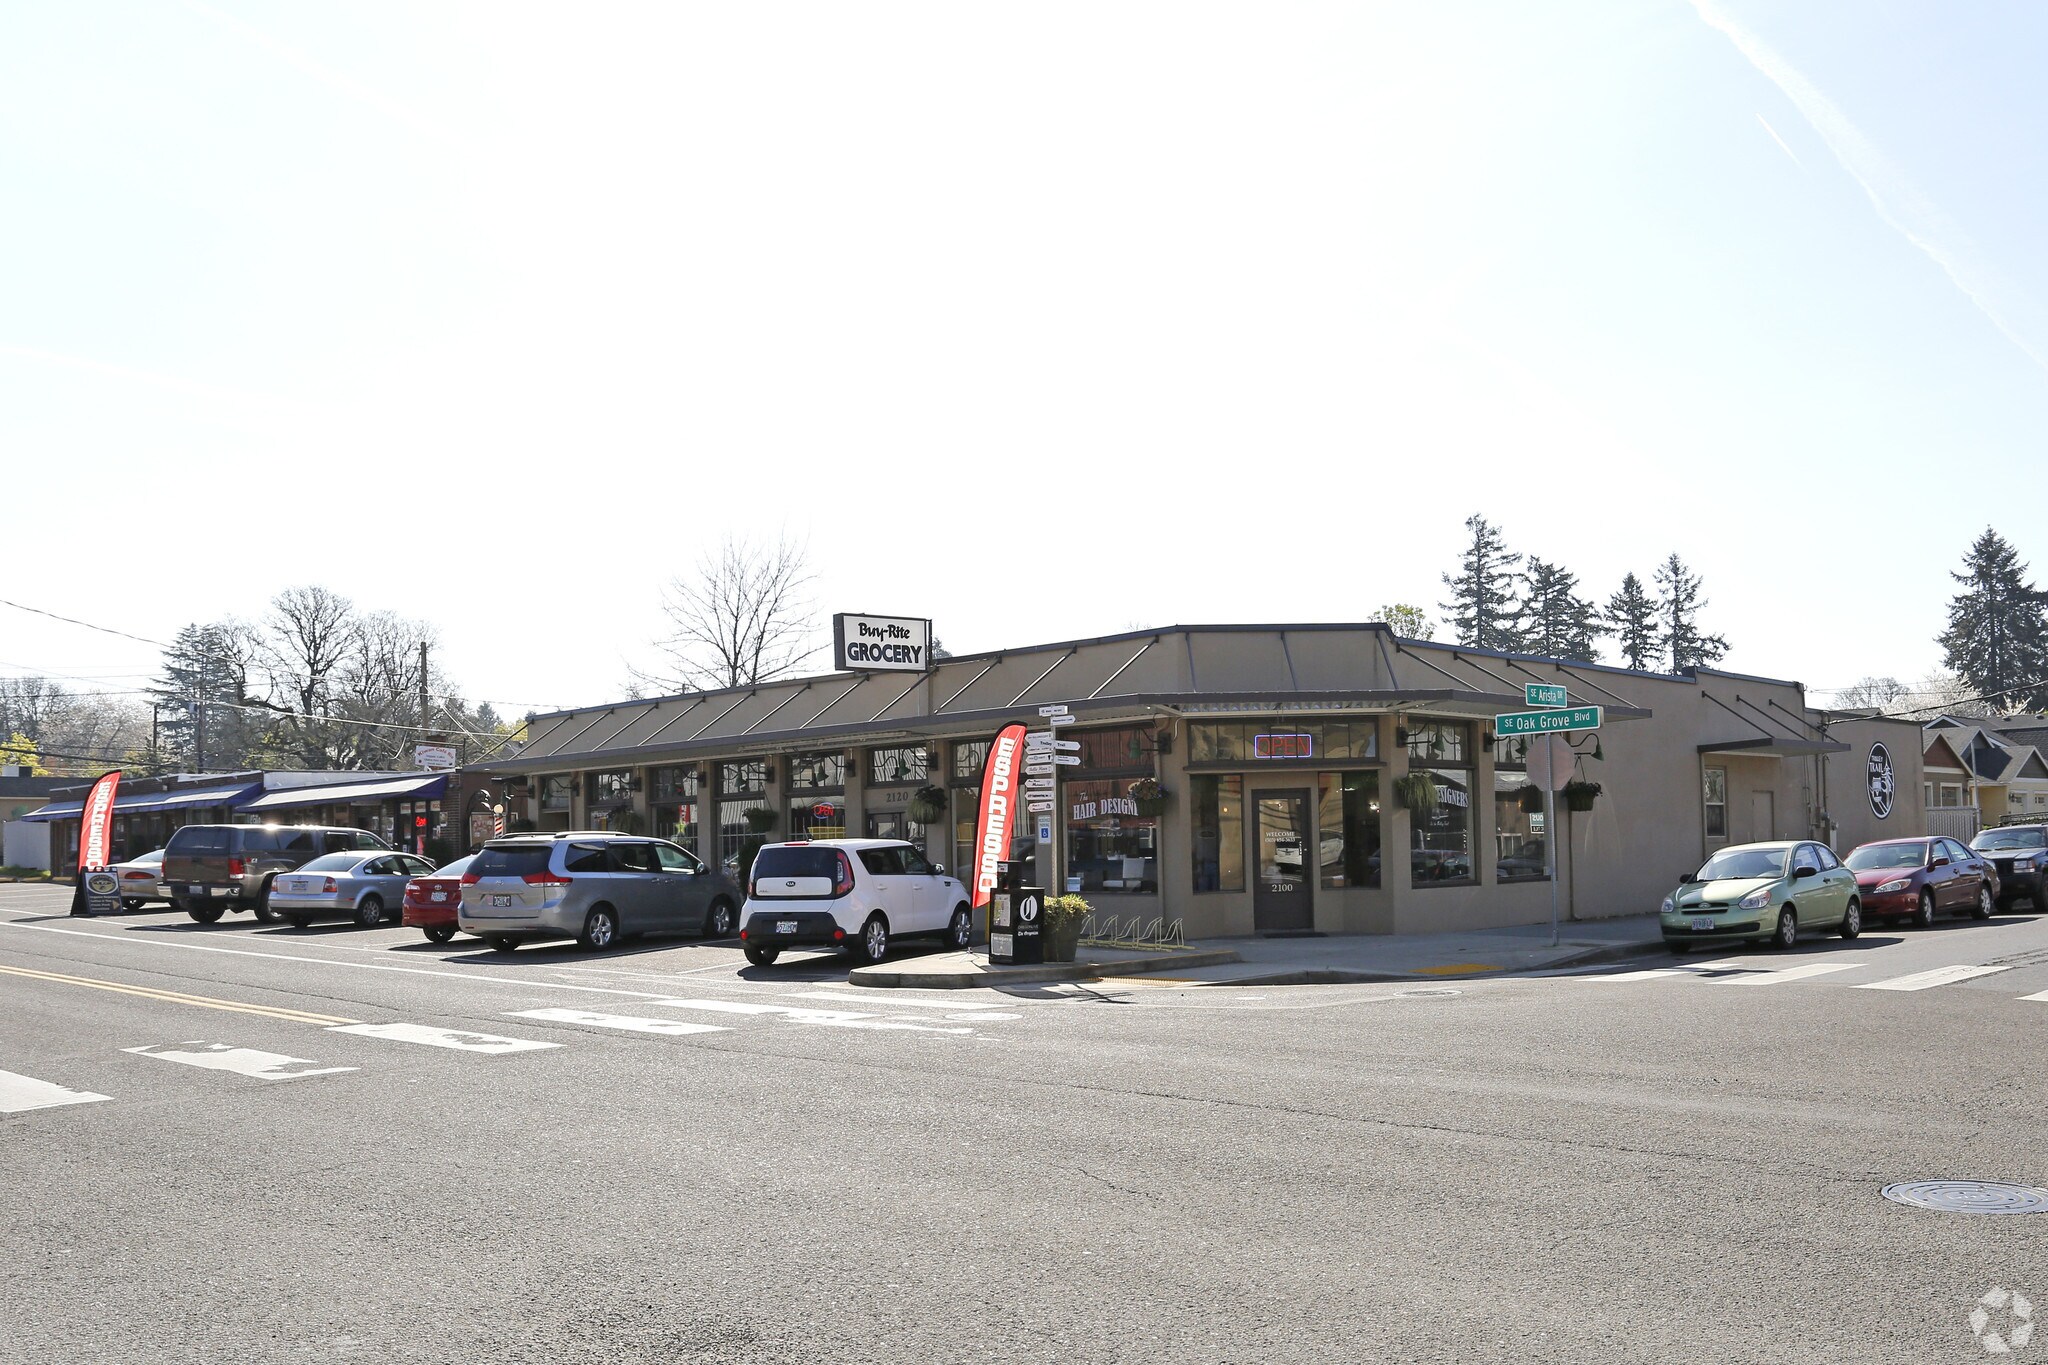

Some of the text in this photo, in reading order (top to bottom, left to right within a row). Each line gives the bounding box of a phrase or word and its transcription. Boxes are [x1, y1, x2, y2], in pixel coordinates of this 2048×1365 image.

[858, 622, 911, 642] Buy-Rite
[847, 642, 922, 664] GROCERY
[1530, 688, 1563, 702] SE Arista DR
[1504, 712, 1590, 730] SE Oak Grove Blvd
[1257, 737, 1310, 756] OPEN
[1869, 762, 1884, 773] TRAIL
[886, 791, 909, 802] 2120
[1080, 792, 1088, 801] The
[814, 804, 835, 817] OPEN
[1073, 802, 1097, 820] HAIR
[1271, 884, 1293, 892] 2100
